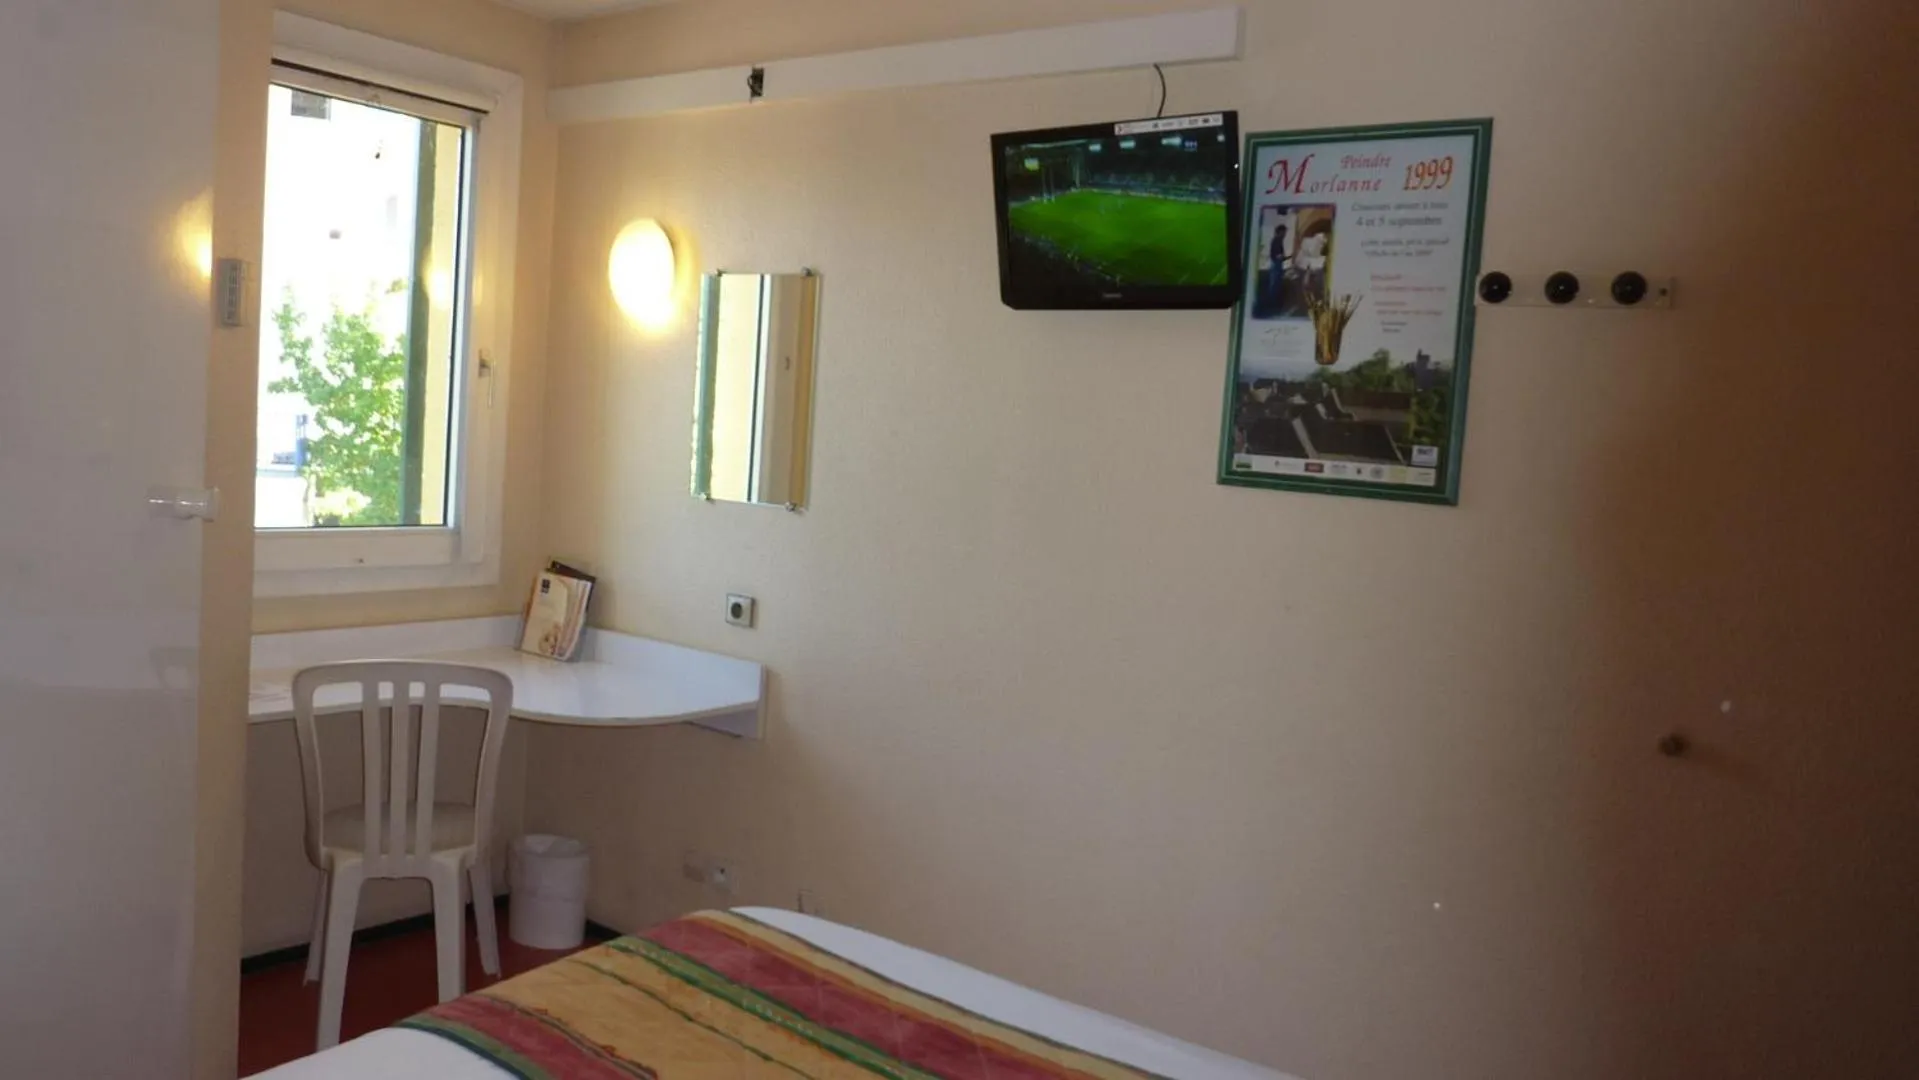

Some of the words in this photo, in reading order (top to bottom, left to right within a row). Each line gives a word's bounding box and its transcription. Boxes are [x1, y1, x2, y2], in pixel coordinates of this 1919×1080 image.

[1265, 153, 1382, 195] Morlanne
[1403, 155, 1454, 191] 1999
[1340, 153, 1392, 170] Peindre
